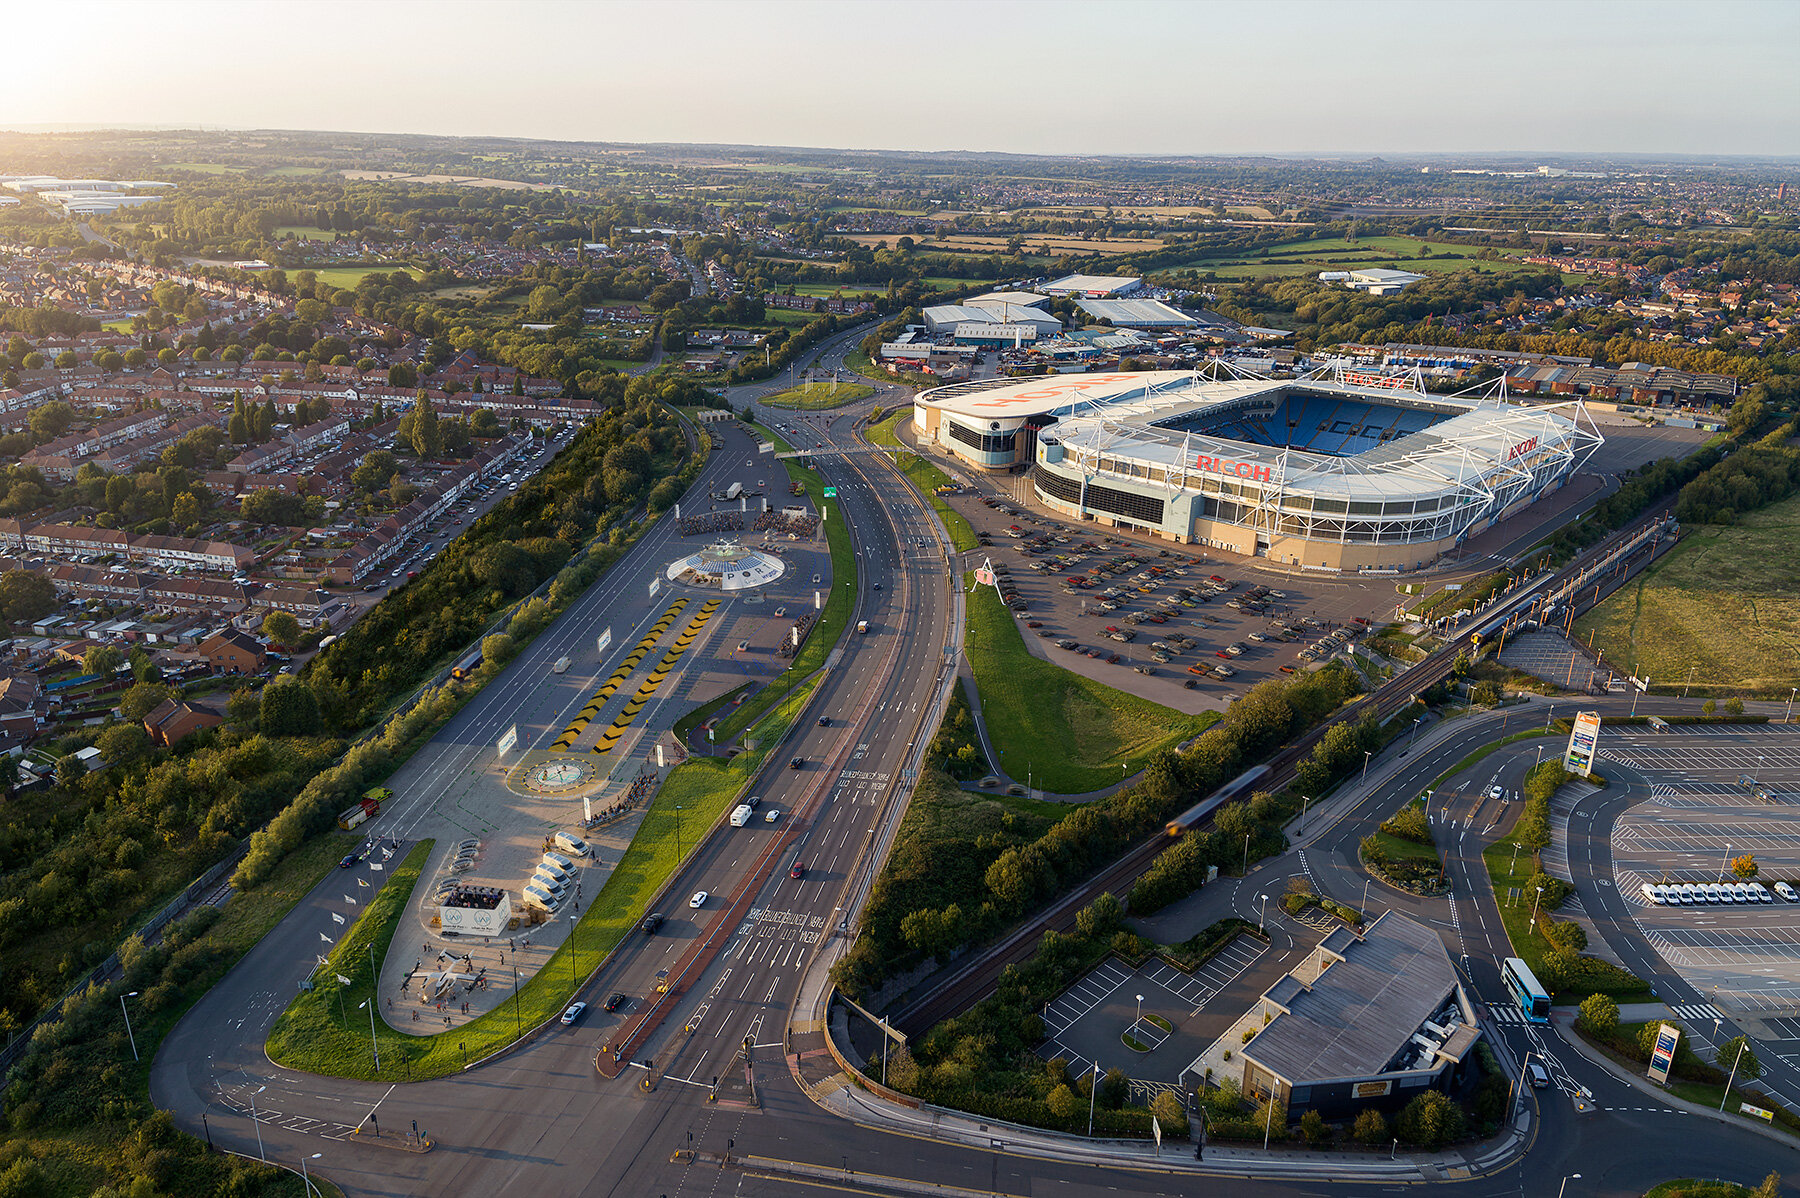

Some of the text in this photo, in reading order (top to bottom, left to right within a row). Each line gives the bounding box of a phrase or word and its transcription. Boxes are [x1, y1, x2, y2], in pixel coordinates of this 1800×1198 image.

[972, 375, 1139, 407] RICOH
[1508, 435, 1538, 461] RICOH
[1196, 454, 1271, 482] RICOH
[746, 908, 763, 921] PARK
[808, 915, 826, 929] PARK
[738, 923, 754, 936] CAR
[757, 925, 776, 938] CITY
[778, 928, 797, 941] CITY
[799, 931, 821, 944] ARENA
